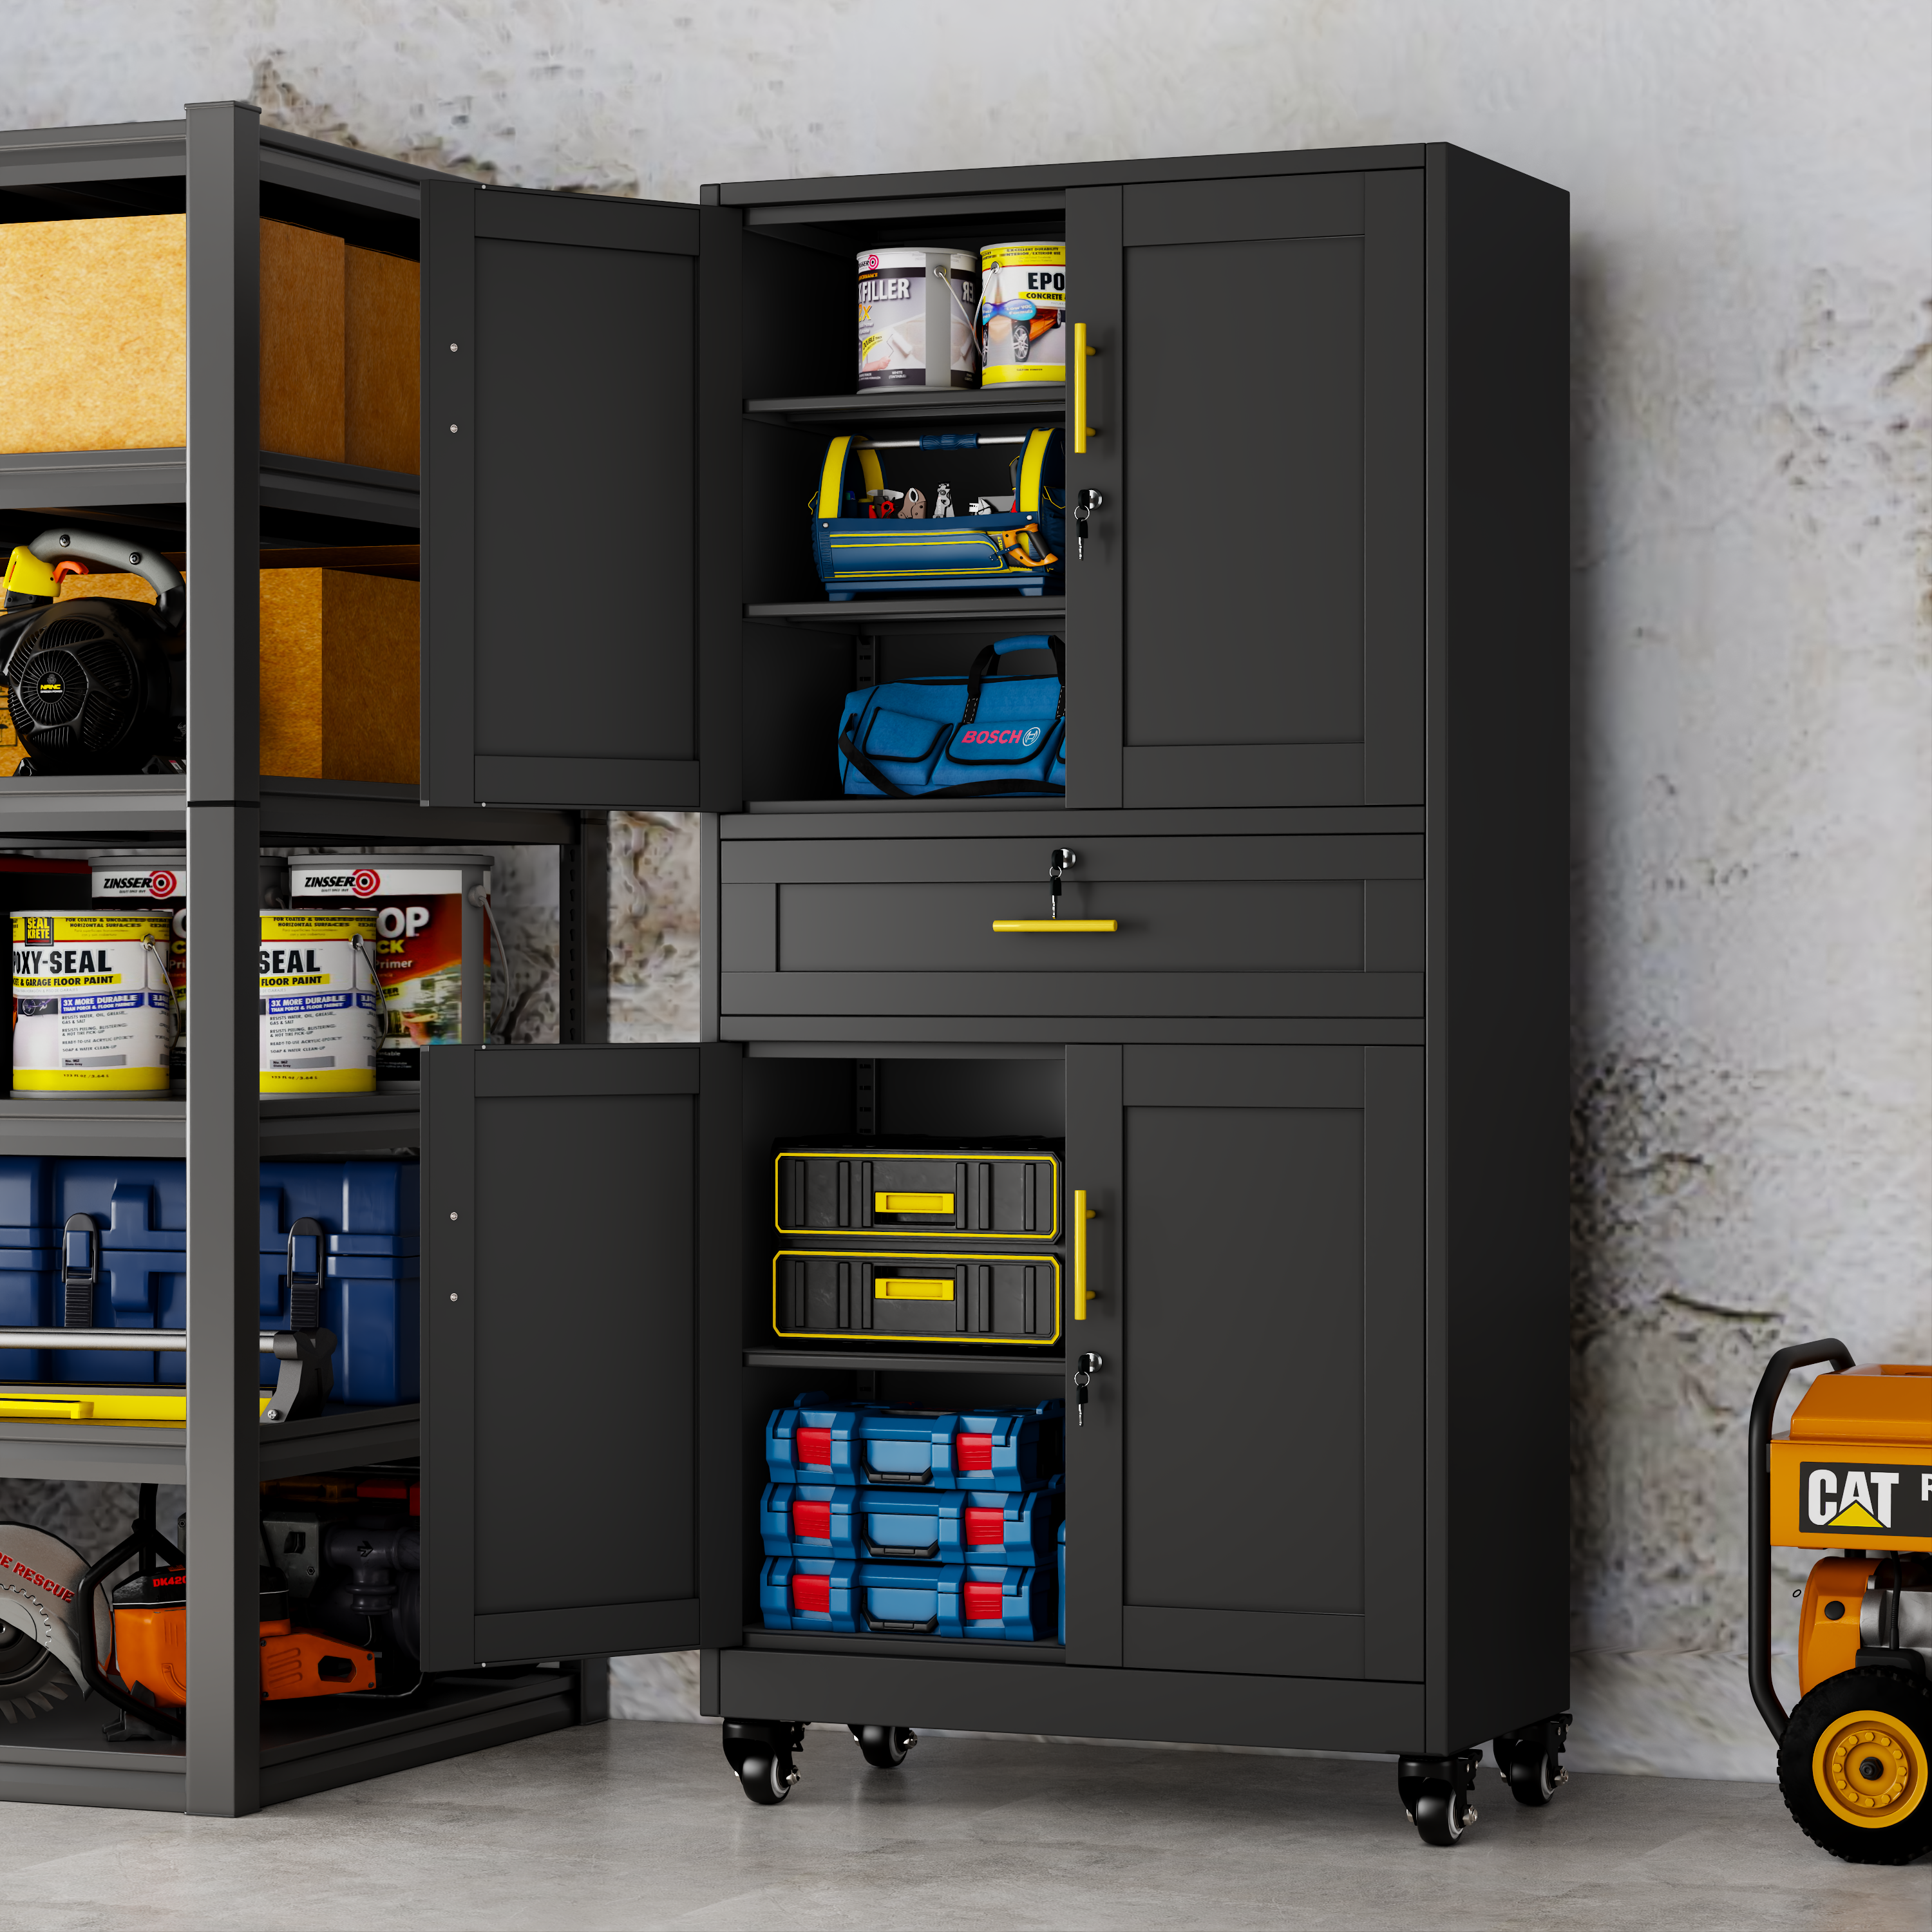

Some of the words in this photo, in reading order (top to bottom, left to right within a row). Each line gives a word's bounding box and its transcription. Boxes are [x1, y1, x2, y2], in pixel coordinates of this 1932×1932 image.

[1028, 272, 1065, 290] EPO
[863, 278, 910, 301] FILLER
[961, 730, 1023, 744] BOSCH
[104, 878, 153, 889] ZINSSER
[305, 876, 355, 887] ZINSSER
[27, 918, 50, 929] SEAL
[376, 907, 430, 938] OP
[27, 929, 50, 939] KRETE
[13, 950, 112, 974] POXY-SEAL
[260, 950, 320, 974] SEAL
[26, 978, 52, 987] GARAGE
[53, 977, 81, 986] FLOOR
[84, 976, 113, 985] PAINT
[261, 978, 289, 986] FLOOR
[292, 976, 322, 985] PAINT
[97, 994, 137, 1004] DURABLE
[305, 995, 346, 1005] DURABLE
[1808, 1469, 1899, 1528] CAT
[12, 1561, 75, 1604] RESCUE
